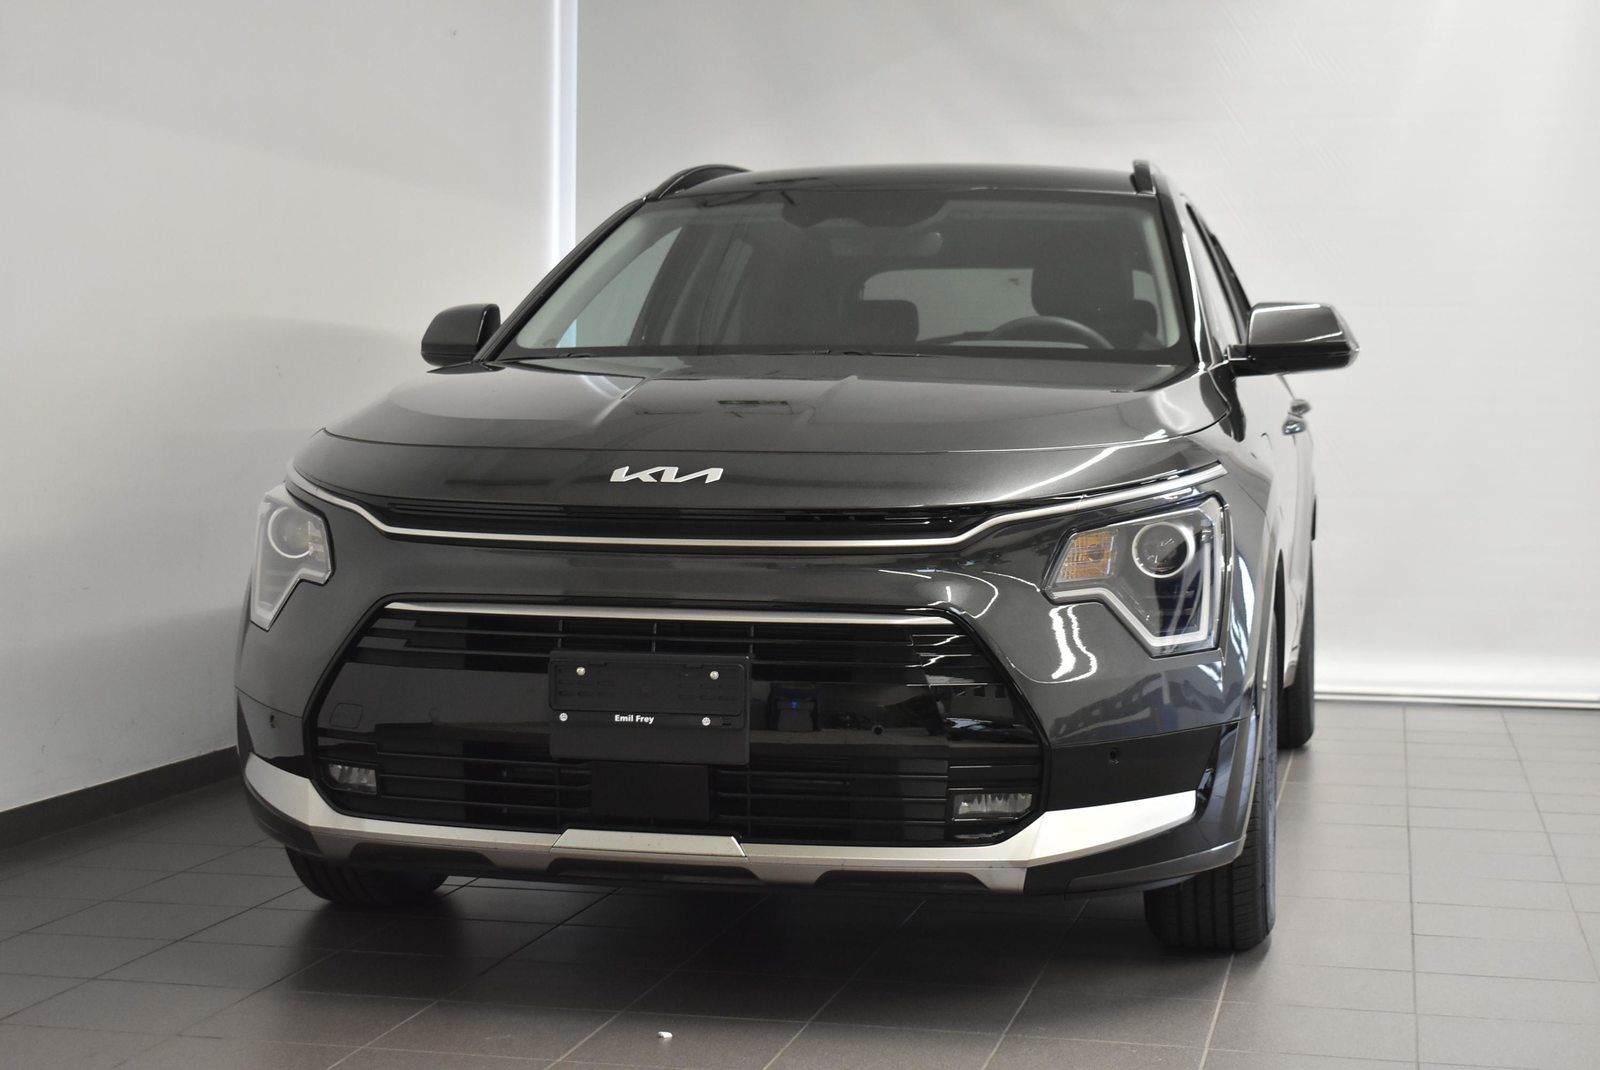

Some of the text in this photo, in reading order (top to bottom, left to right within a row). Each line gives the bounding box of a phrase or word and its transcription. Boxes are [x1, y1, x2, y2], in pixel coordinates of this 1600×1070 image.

[609, 465, 724, 484] KIA
[614, 714, 655, 725] Emil Frey
